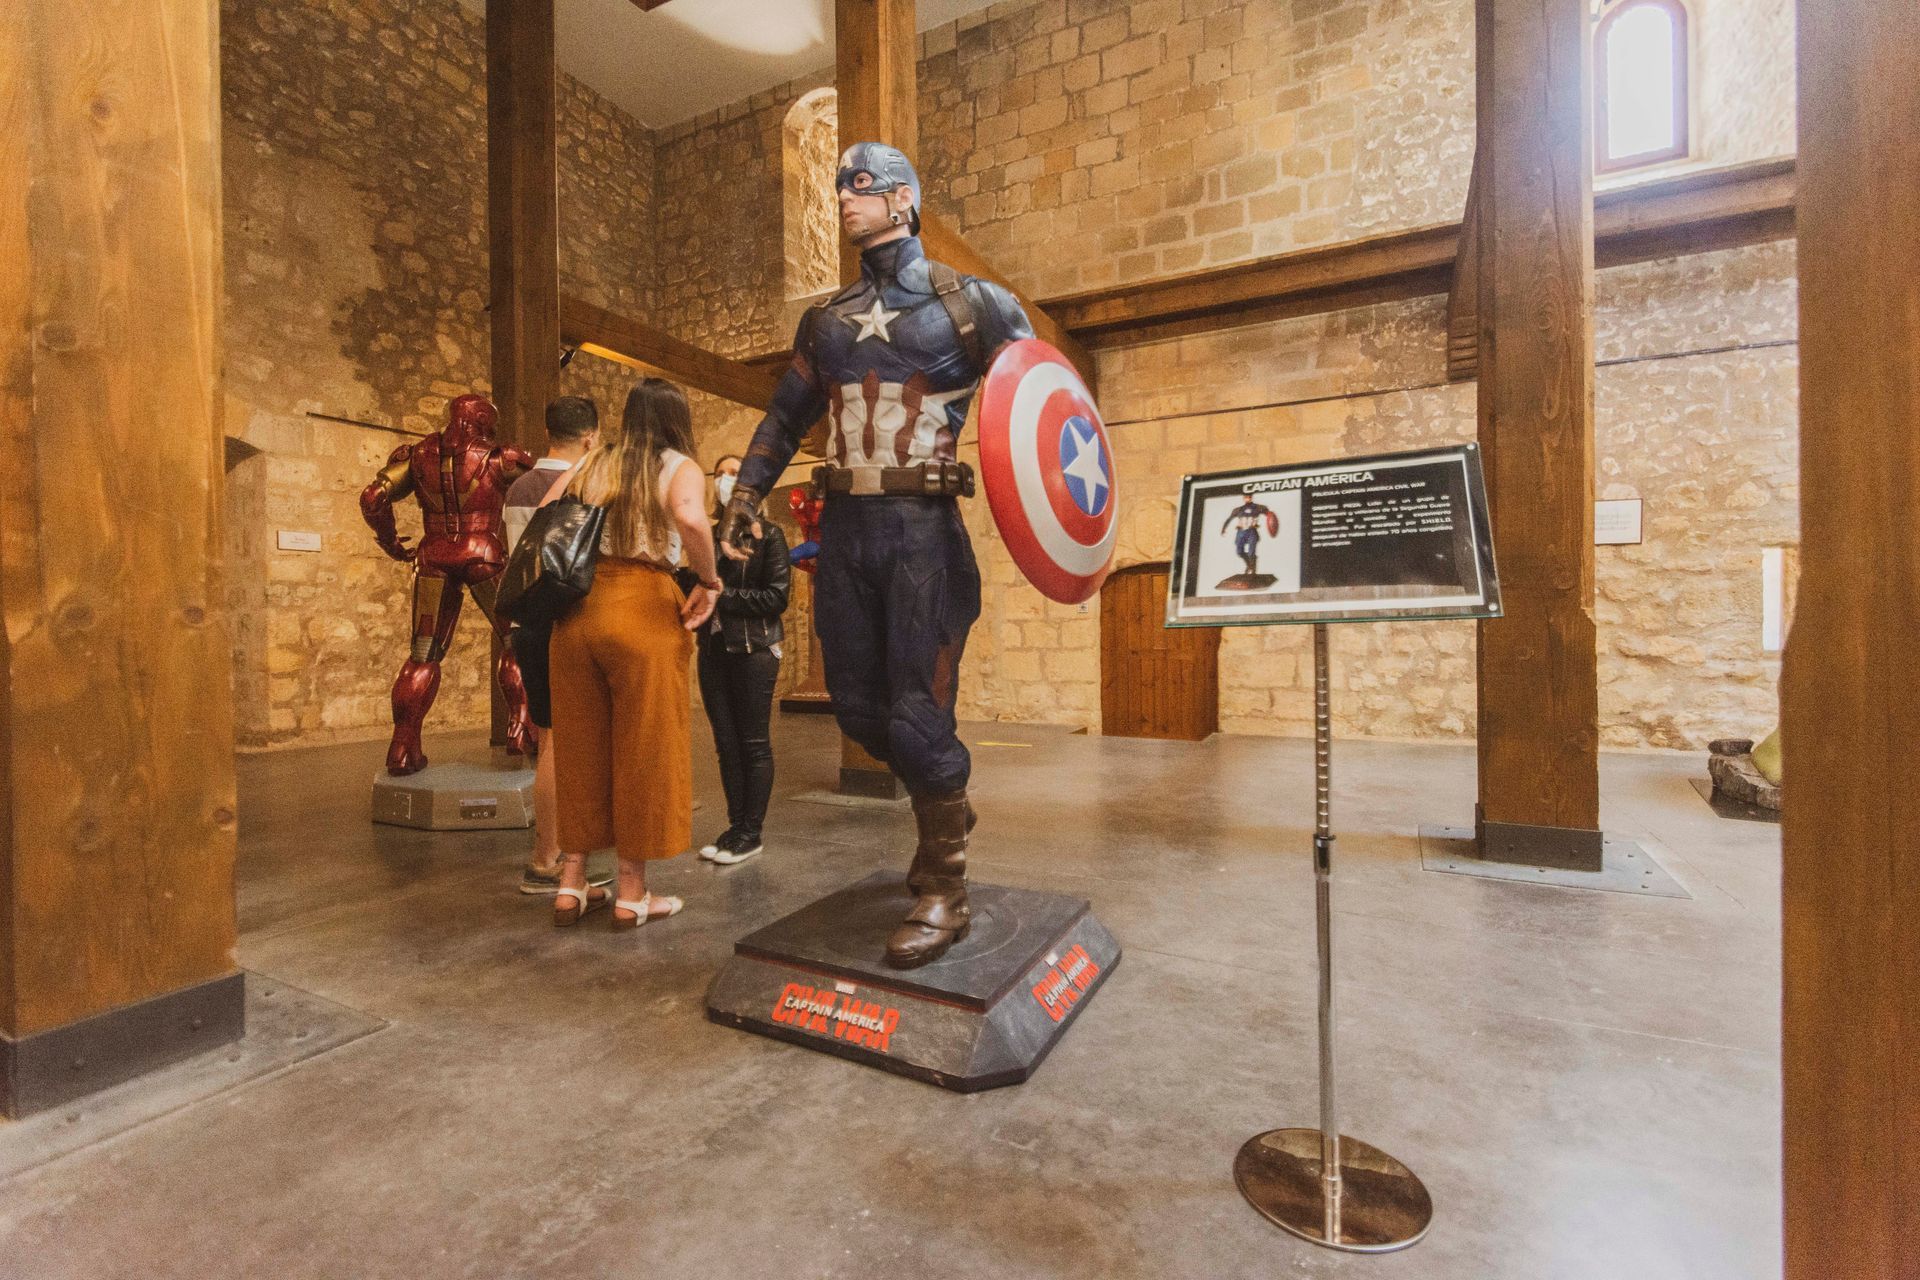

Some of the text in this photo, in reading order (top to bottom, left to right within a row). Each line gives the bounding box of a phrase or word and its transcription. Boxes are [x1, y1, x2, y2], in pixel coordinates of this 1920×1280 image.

[1304, 472, 1374, 487] AMÉRICA
[785, 997, 885, 1033] CAPTAIN AMERICA
